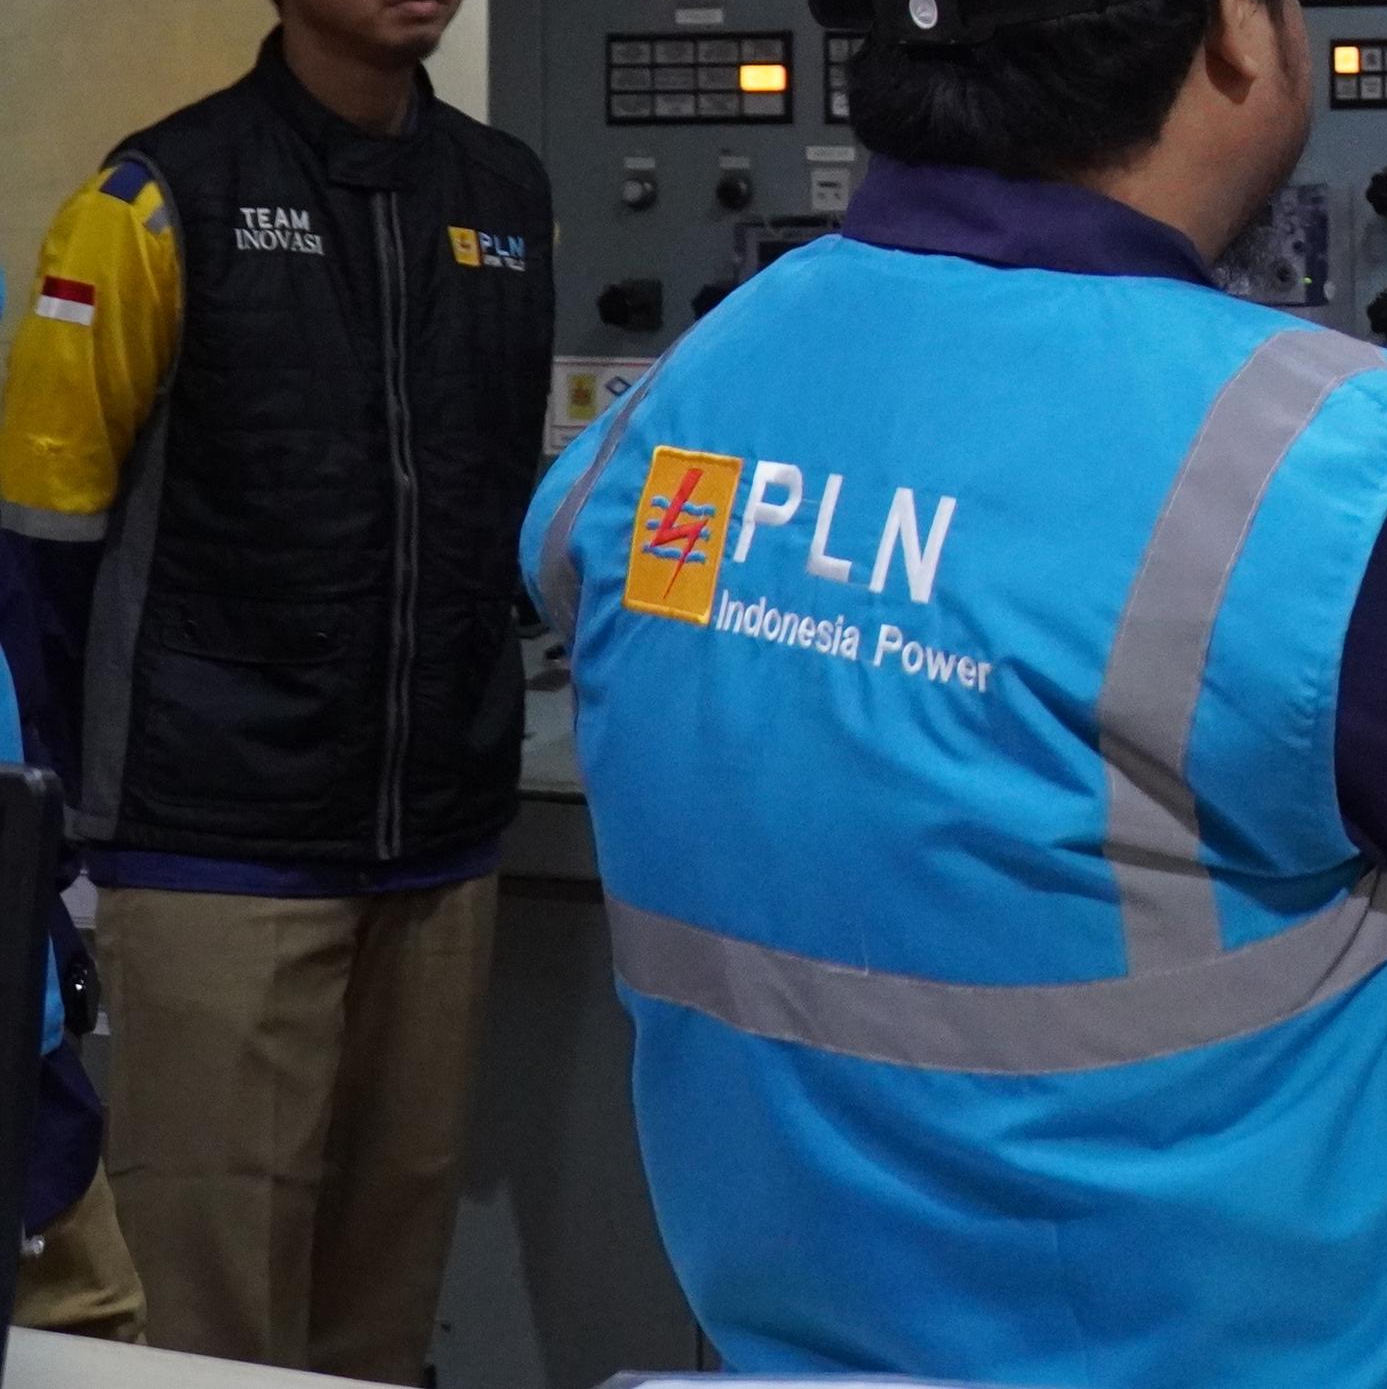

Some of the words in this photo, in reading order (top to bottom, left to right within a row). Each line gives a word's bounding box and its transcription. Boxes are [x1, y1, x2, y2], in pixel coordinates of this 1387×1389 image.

[240, 207, 310, 231] TEAM
[235, 228, 325, 256] INOVASI
[479, 232, 527, 258] PLN
[733, 460, 957, 604] PLN
[715, 589, 861, 662] Indonesia
[874, 623, 992, 693] Power
